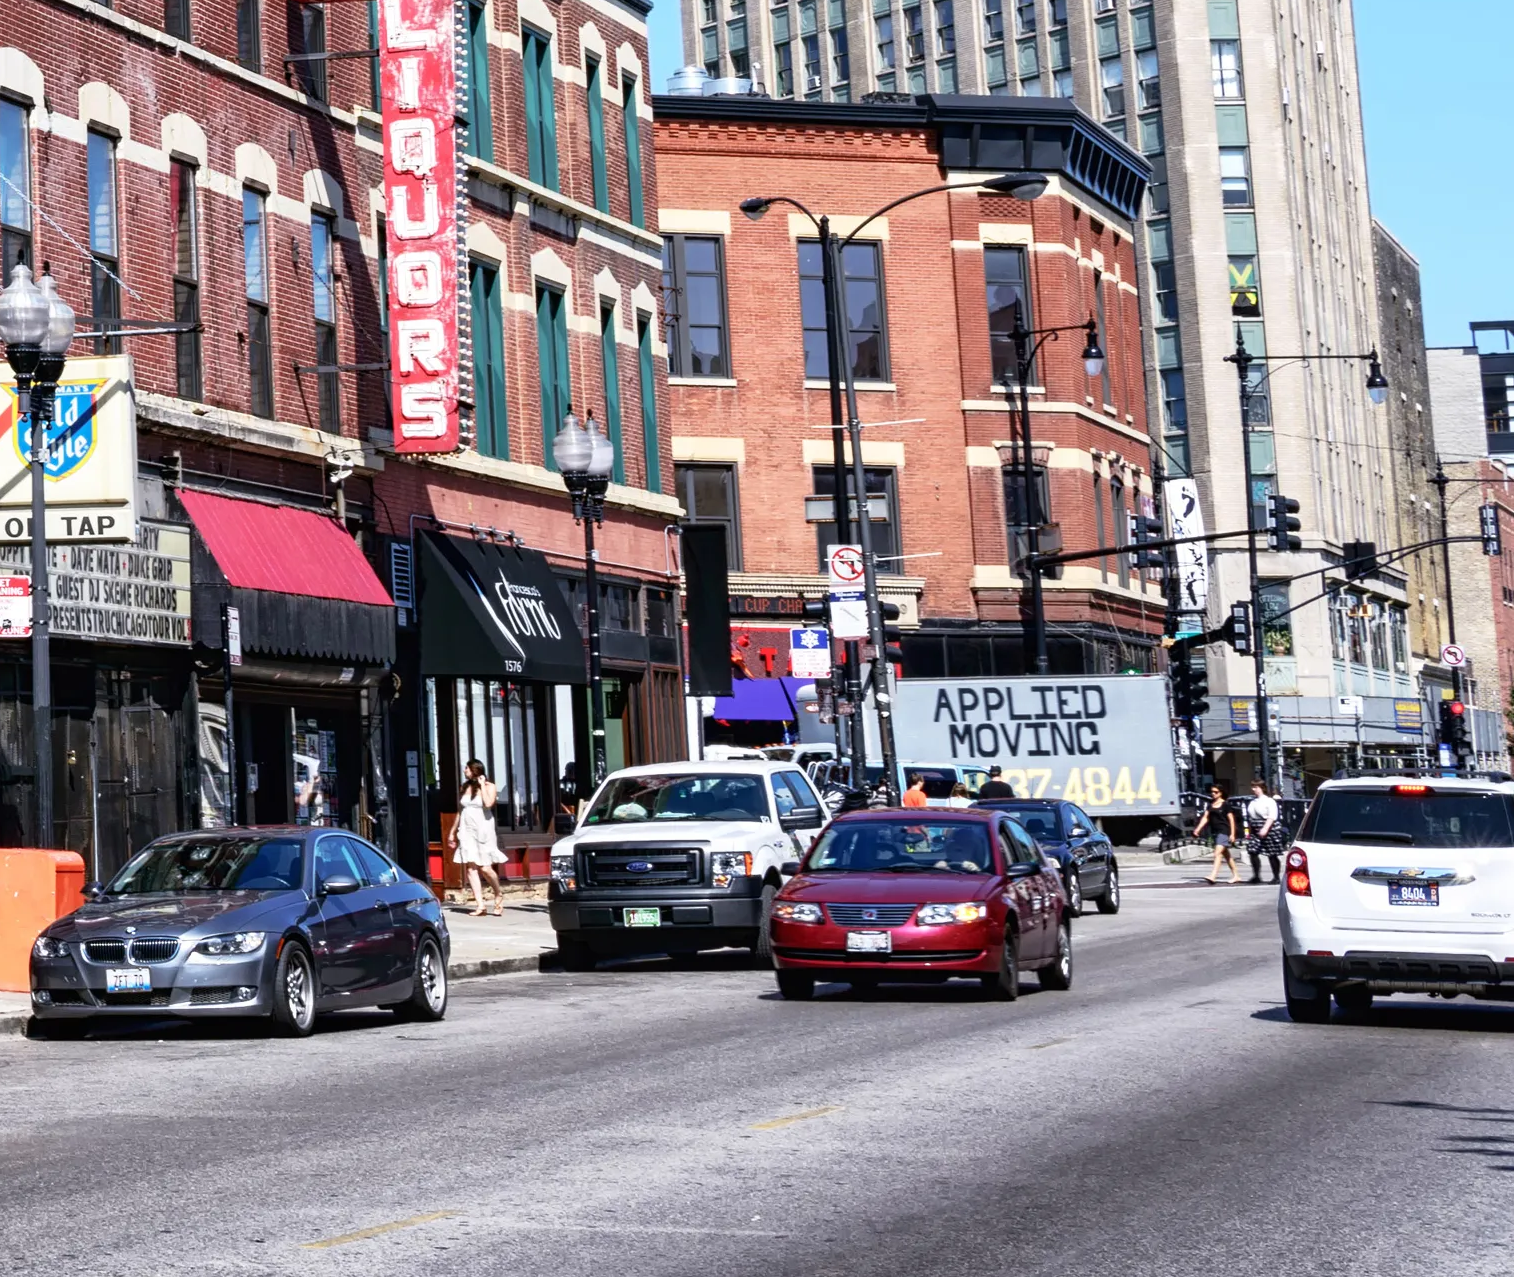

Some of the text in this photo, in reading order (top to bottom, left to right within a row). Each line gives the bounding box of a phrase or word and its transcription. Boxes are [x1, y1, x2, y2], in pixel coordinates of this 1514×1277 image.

[61, 516, 115, 536] TAP
[138, 526, 159, 551] ARTY
[72, 547, 93, 572] DAVE
[97, 552, 120, 576] MATA
[128, 554, 149, 579] DUKE
[152, 558, 172, 582] GRIP
[56, 576, 177, 612] GUEST DJ SKEME RICHARDS
[744, 598, 804, 614] CUP CHA
[505, 660, 522, 673] 1576
[934, 684, 1107, 723] APPLIED
[949, 721, 1101, 758] MOVING
[1001, 766, 1161, 806] 37-4844
[1401, 887, 1426, 900] 8404
